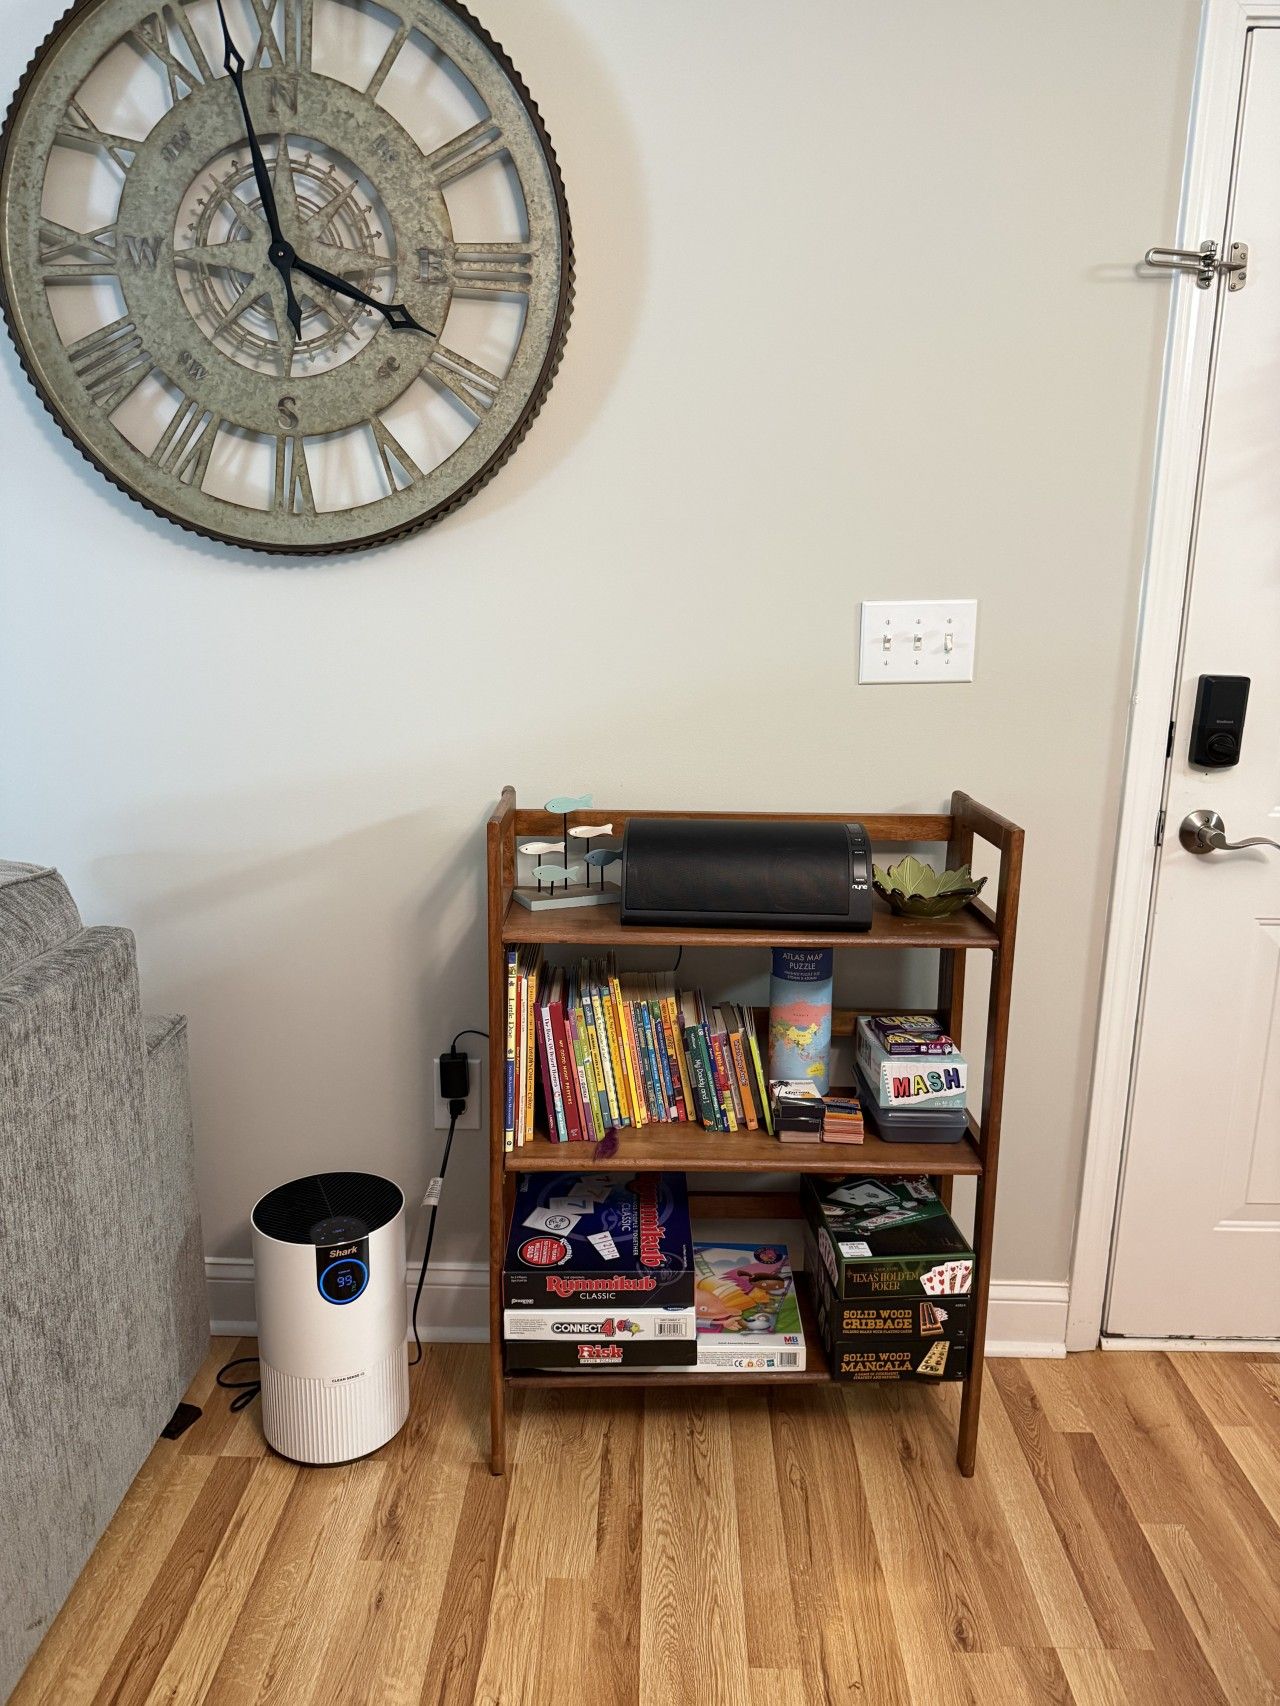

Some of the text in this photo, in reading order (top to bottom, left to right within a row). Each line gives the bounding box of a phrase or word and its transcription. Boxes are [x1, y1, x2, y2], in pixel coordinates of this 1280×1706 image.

[265, 76, 299, 116] N
[123, 234, 166, 269] W
[414, 248, 450, 284] E
[276, 396, 299, 431] S
[782, 953, 823, 961] ATLAS MAP
[789, 962, 816, 970] PUZZLE
[693, 1059, 702, 1069] My
[697, 1068, 706, 1088] Daddy
[700, 1088, 709, 1100] and
[621, 1203, 631, 1232] CLASSIC
[329, 1246, 358, 1258] Shark
[337, 1275, 352, 1287] 99
[852, 1273, 879, 1282] TEXAS
[546, 1275, 657, 1298] Rummikub
[872, 1282, 900, 1291] POKER
[579, 1292, 616, 1300] CLASSIC
[843, 1310, 912, 1318] SOLID WOOD
[553, 1323, 602, 1333] CONNECT
[600, 1318, 617, 1338] 4
[843, 1319, 912, 1329] CRIBBAGE
[577, 1344, 624, 1359] Risk
[843, 1353, 911, 1362] SOLID WOOD
[840, 1361, 912, 1372] MANCALA
